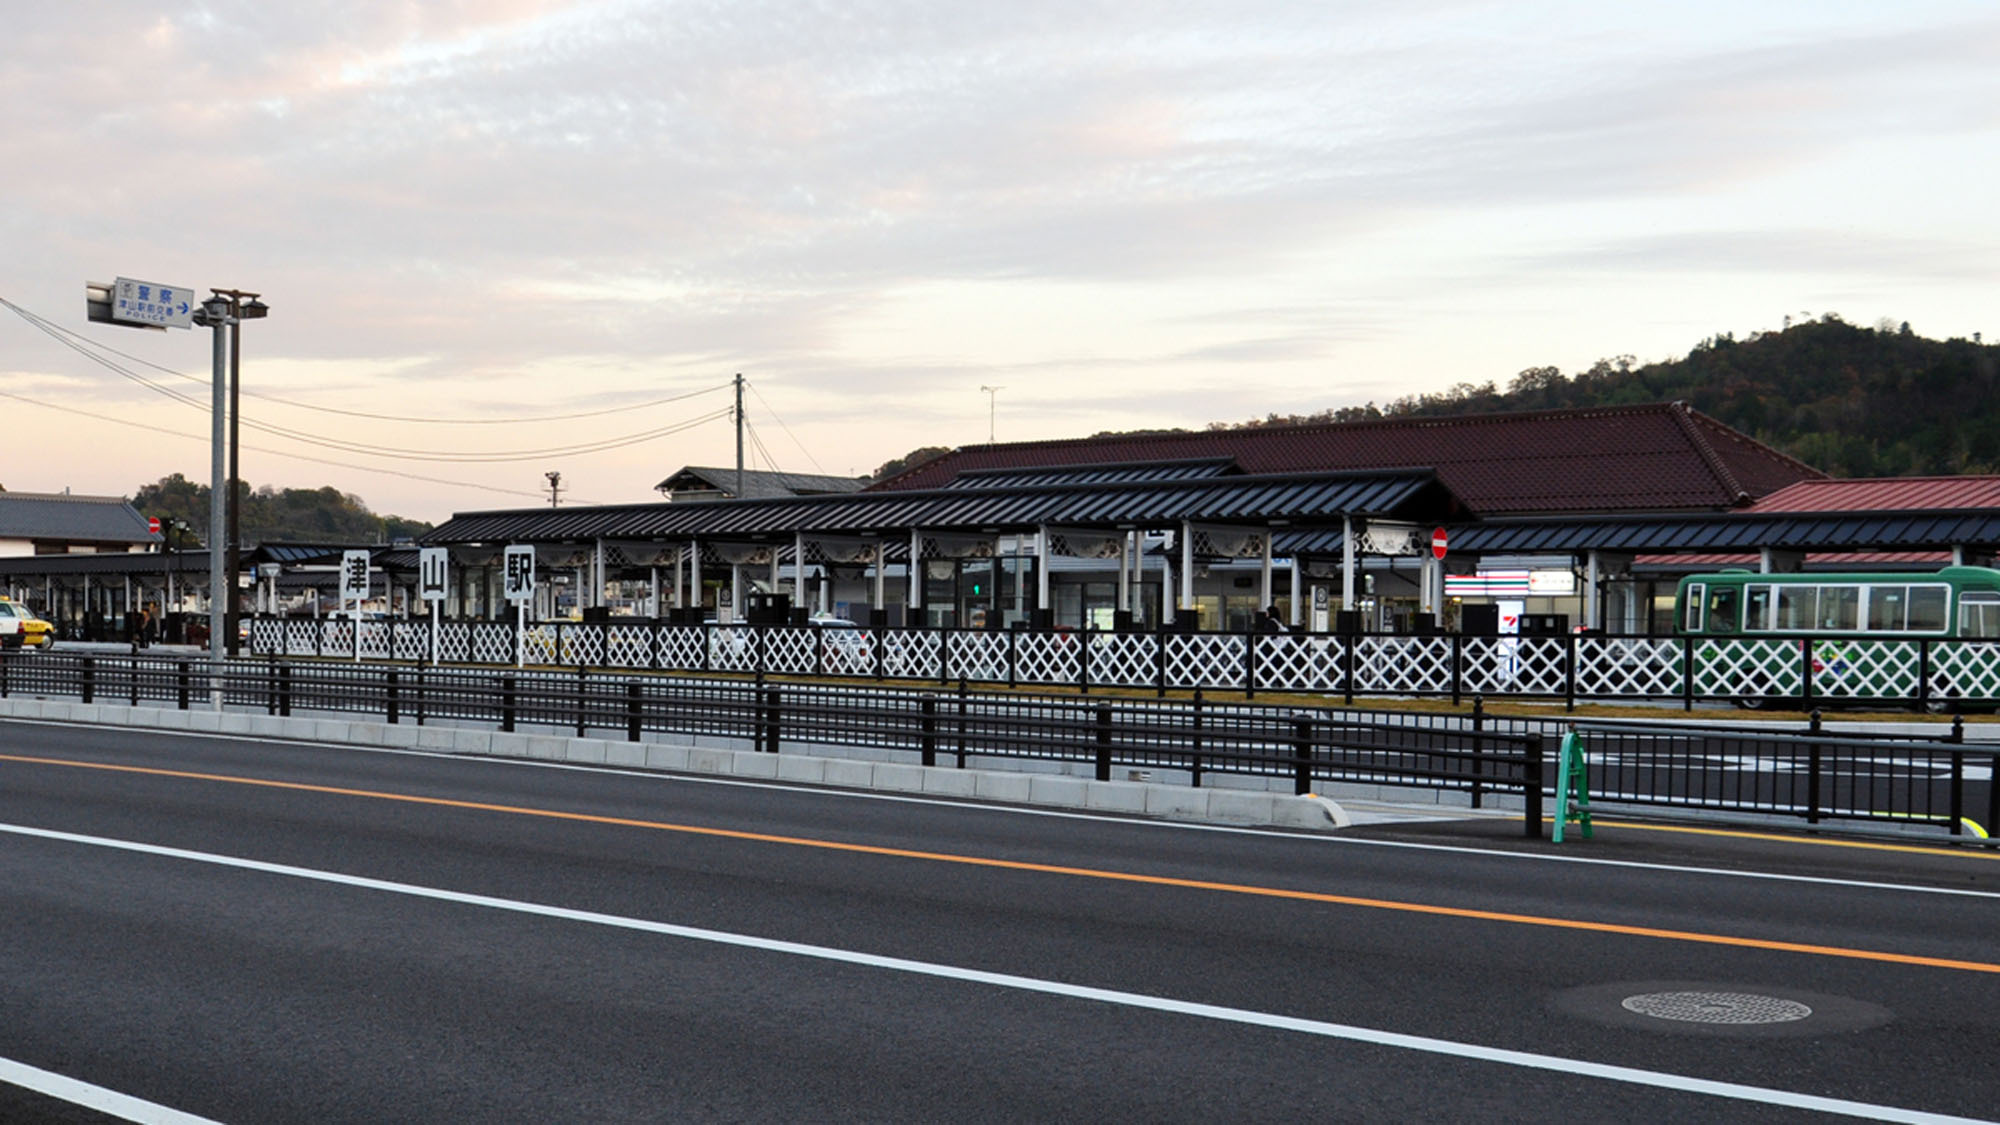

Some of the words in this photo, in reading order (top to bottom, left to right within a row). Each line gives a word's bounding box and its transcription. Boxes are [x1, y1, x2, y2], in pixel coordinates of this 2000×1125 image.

[138, 285, 172, 304] 警察
[119, 299, 173, 317] 津山駅前交番
[126, 310, 166, 322] POLICE
[346, 556, 367, 593] 津
[423, 554, 444, 593] 山
[507, 553, 532, 592] 駅
